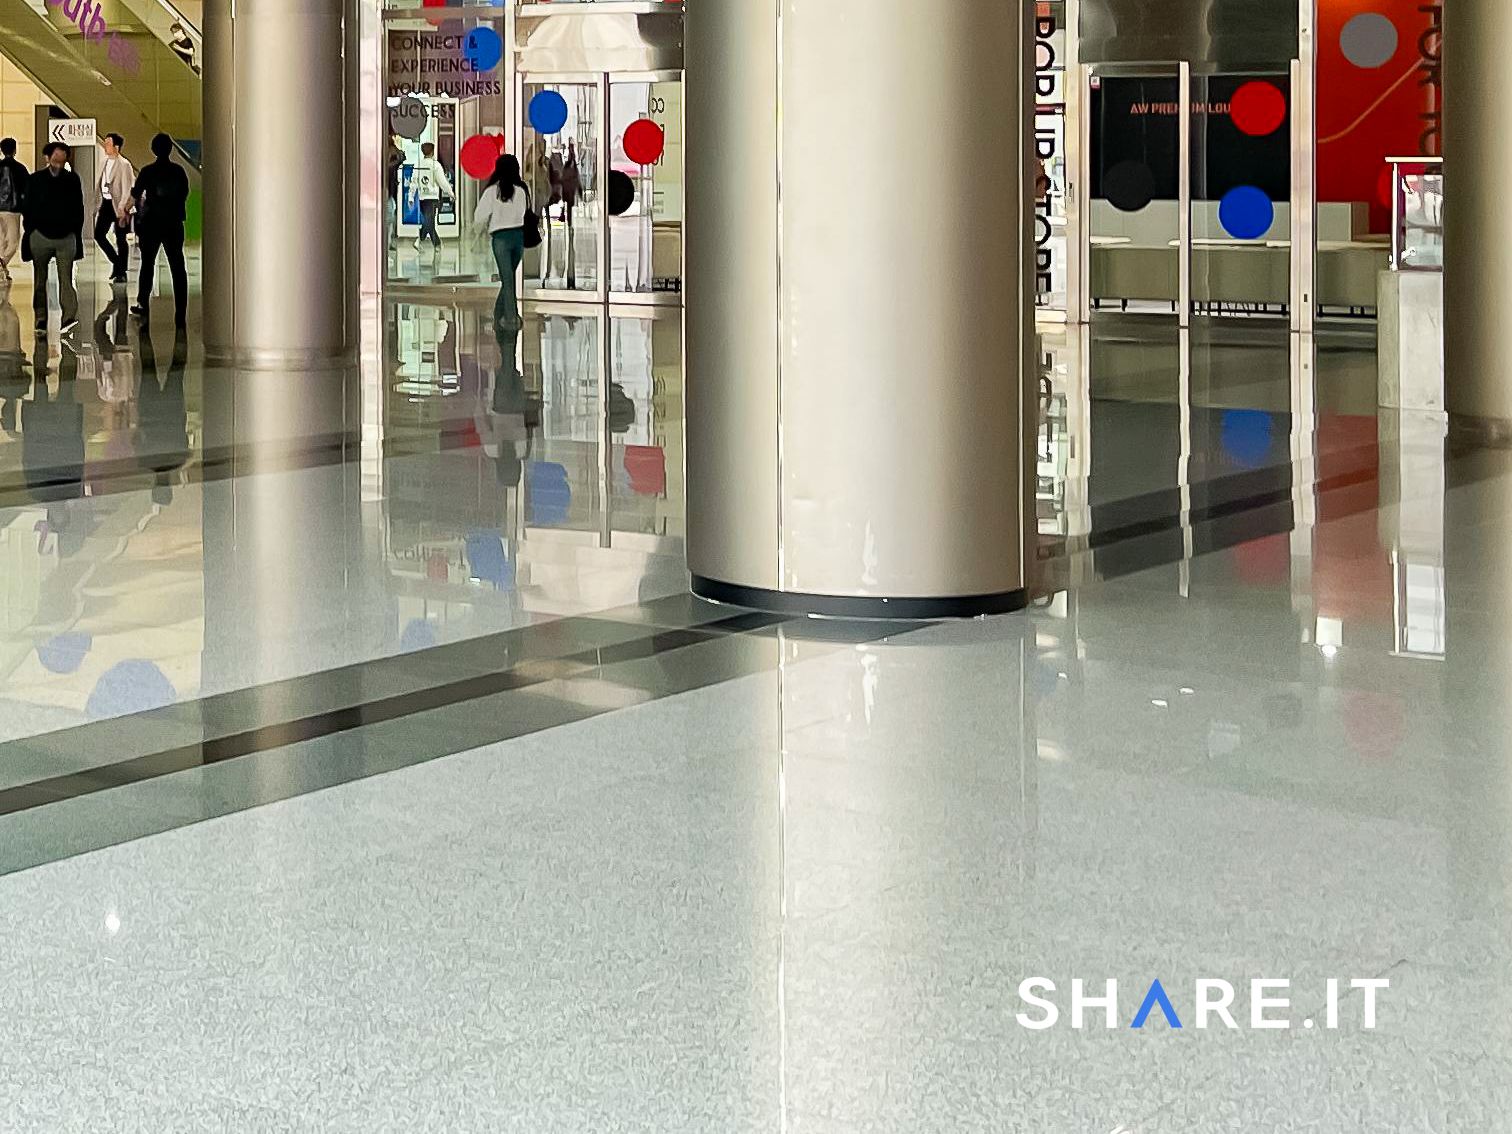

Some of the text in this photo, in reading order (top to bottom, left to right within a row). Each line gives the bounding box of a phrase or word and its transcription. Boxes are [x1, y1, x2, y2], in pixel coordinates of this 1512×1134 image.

[391, 35, 478, 51] CONNECT &
[391, 57, 479, 73] EXPERIENCE
[391, 80, 501, 96] YOUR BUSINESS
[391, 105, 455, 119] SUCCESS
[1208, 102, 1231, 115] LOU
